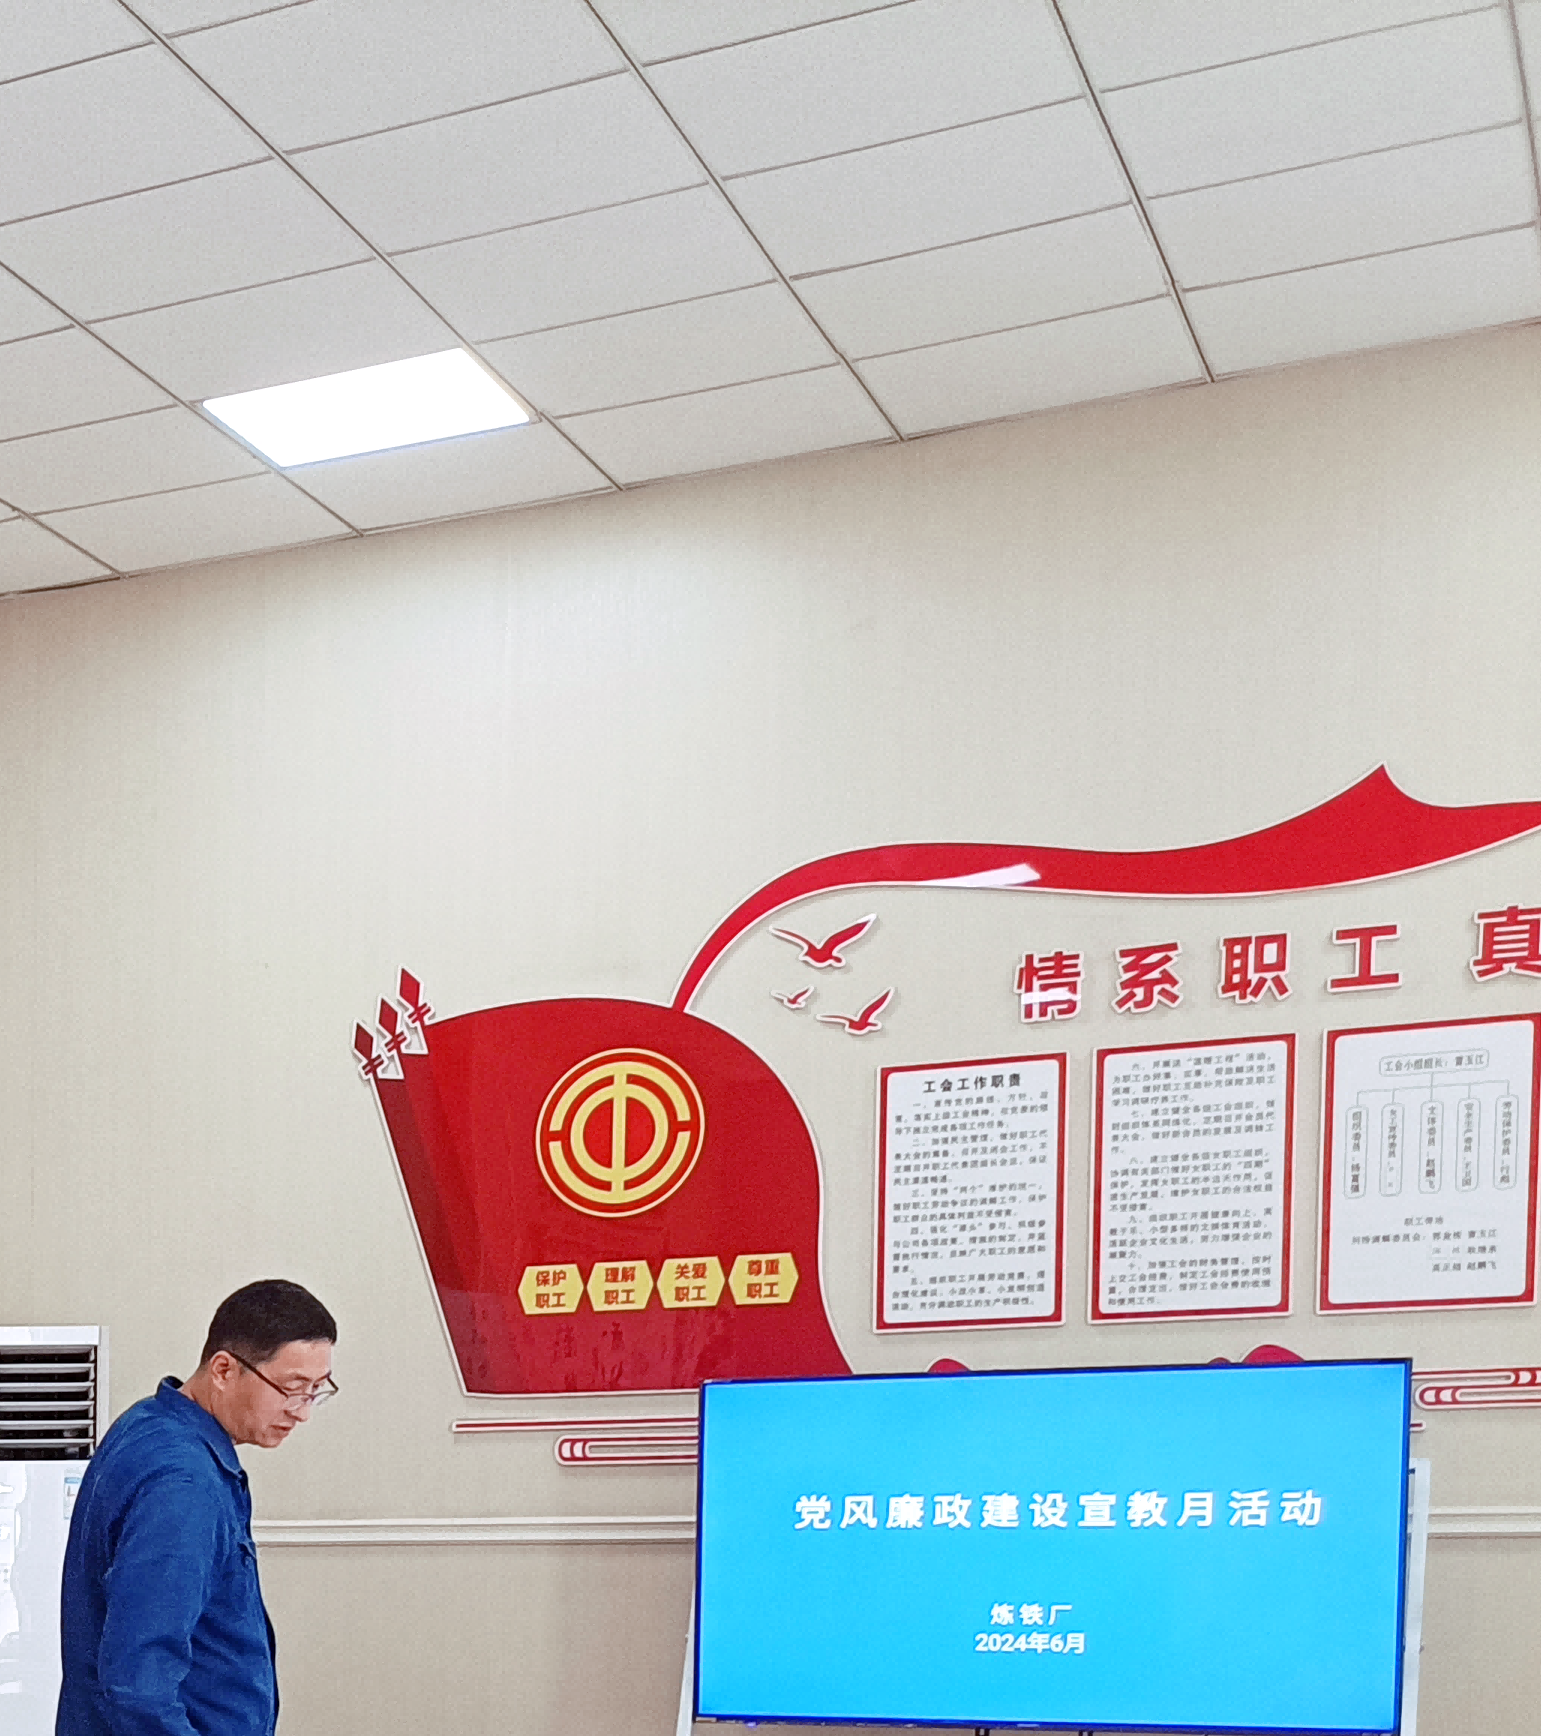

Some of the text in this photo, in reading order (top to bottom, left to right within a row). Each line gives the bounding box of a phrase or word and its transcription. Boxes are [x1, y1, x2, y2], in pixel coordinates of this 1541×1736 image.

[1015, 924, 1403, 1022] 情系职工
[923, 1073, 1021, 1093] 工会工作职责
[604, 1266, 636, 1283] 理解
[674, 1262, 707, 1280] 关爱
[747, 1259, 780, 1277] 尊重
[535, 1270, 567, 1287] 保护
[604, 1289, 636, 1306] 职工
[674, 1285, 707, 1303] 职工
[746, 1282, 779, 1299] 职工
[535, 1292, 566, 1309] 职工
[794, 1489, 1324, 1531] 党风廉政建设宣教月活动
[990, 1602, 1073, 1626] 炼铁厂
[974, 1630, 1087, 1655] 2024年6月
